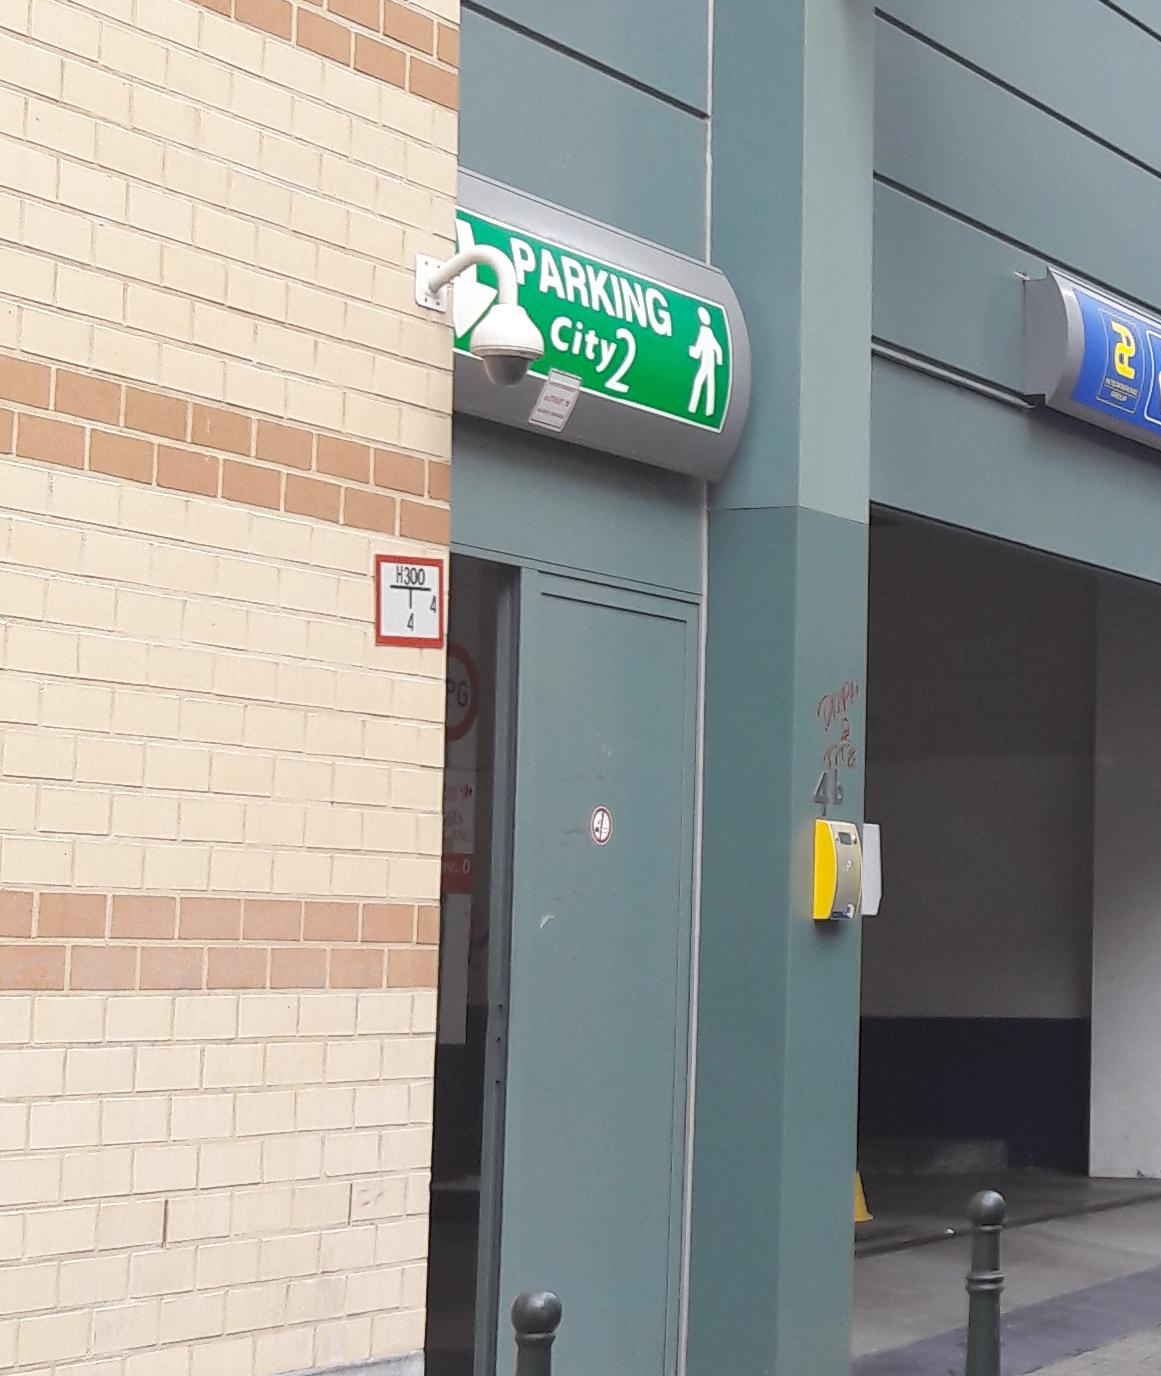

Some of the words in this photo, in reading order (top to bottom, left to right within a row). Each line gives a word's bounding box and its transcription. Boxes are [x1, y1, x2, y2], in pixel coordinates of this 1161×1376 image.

[509, 237, 673, 337] PARKING
[550, 316, 637, 393] City2
[396, 565, 426, 585] H300
[430, 595, 437, 613] 4
[407, 612, 414, 631] 4
